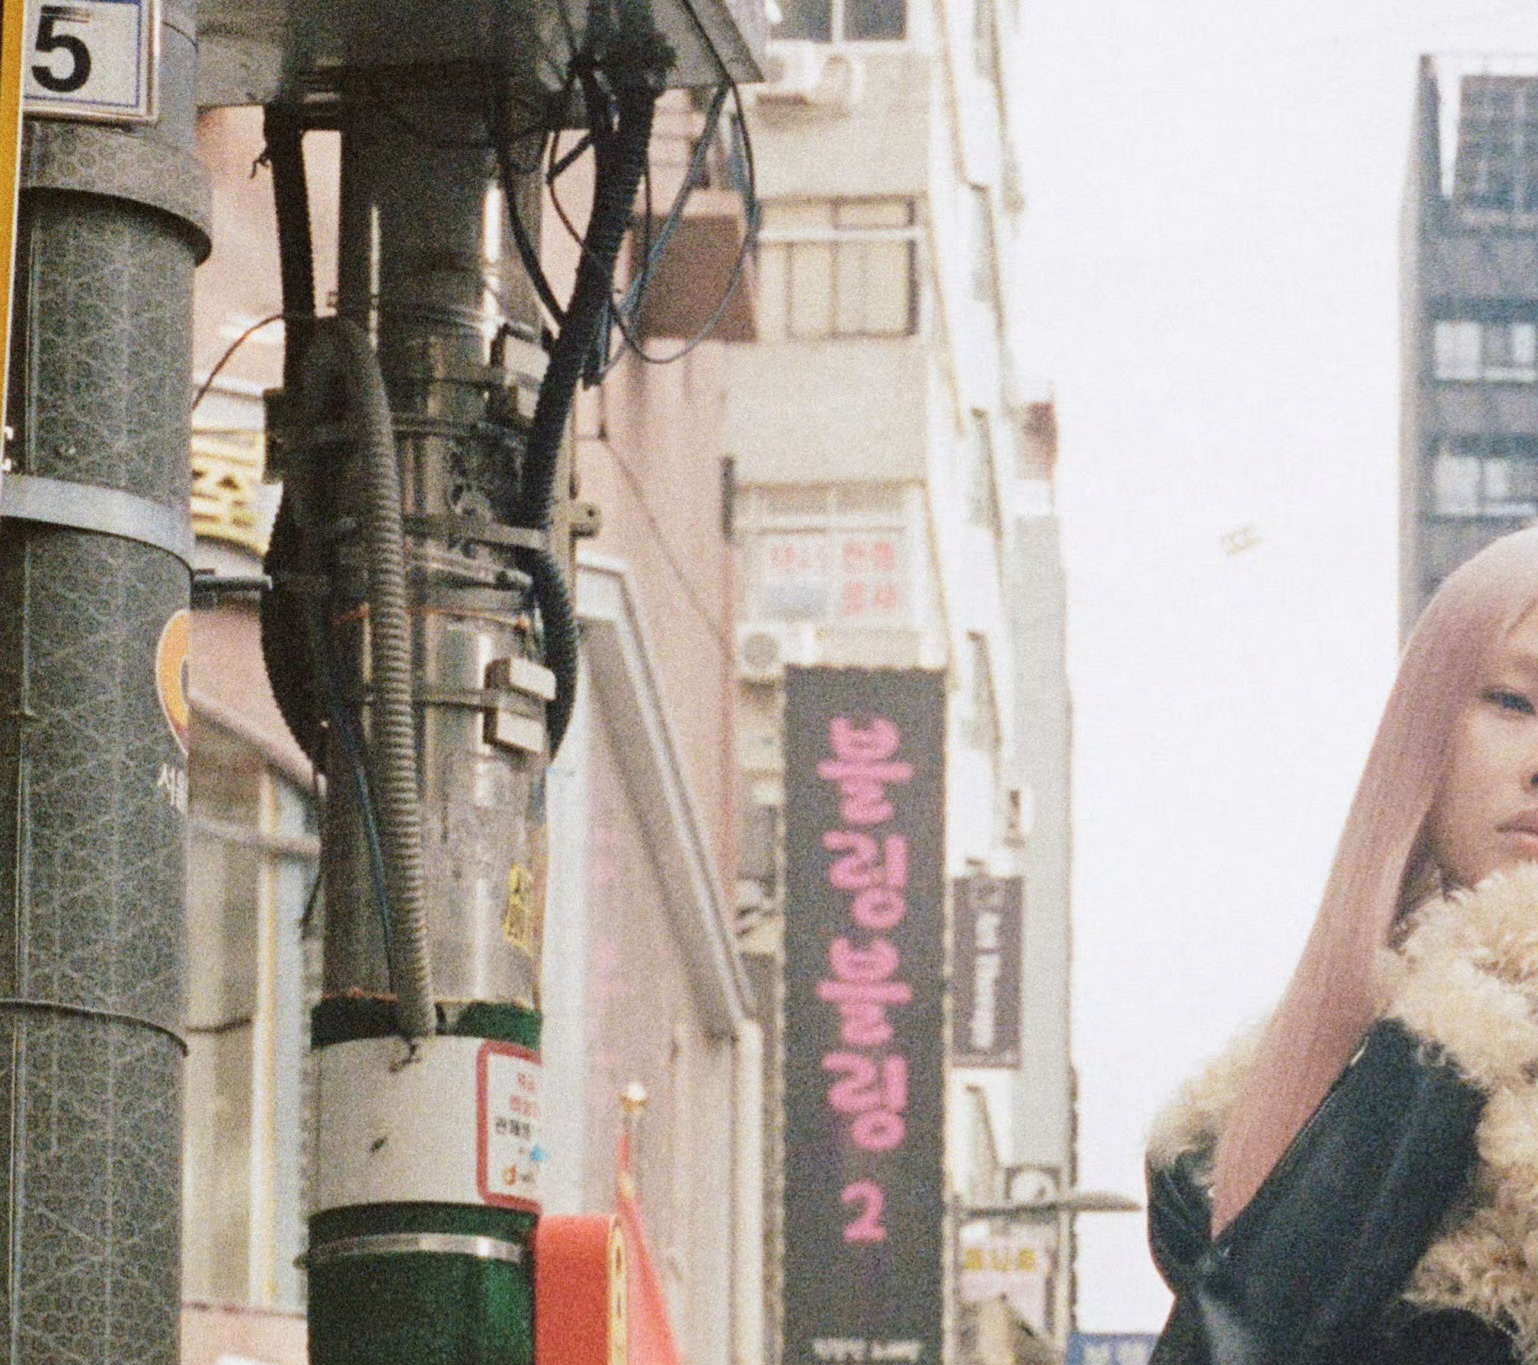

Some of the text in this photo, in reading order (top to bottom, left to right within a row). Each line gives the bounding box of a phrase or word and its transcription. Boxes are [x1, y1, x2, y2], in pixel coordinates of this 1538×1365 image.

[31, 5, 92, 93] 5
[816, 716, 914, 1242] 블링블링 2
